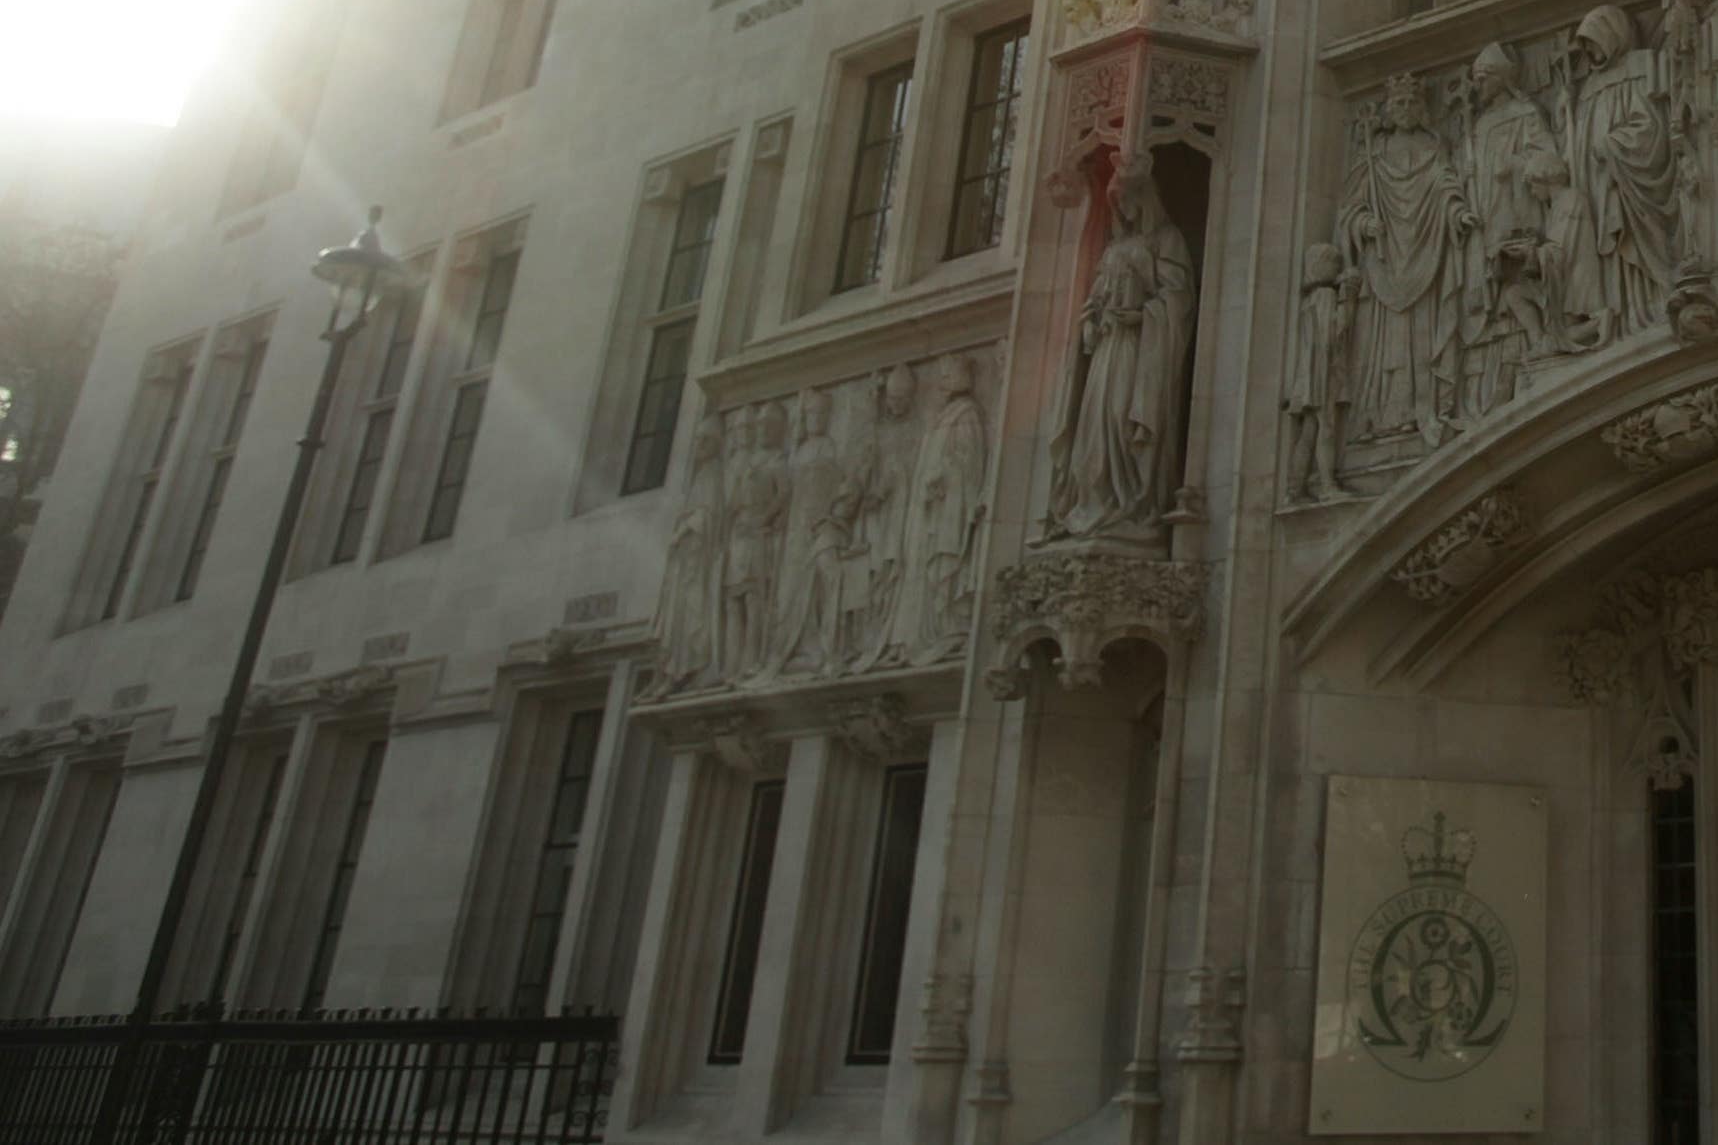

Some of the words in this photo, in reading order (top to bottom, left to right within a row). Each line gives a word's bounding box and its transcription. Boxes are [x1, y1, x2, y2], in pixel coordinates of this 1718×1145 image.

[1353, 942, 1376, 990] THE
[1372, 889, 1473, 936] SUPREME
[1475, 914, 1512, 997] COURT
